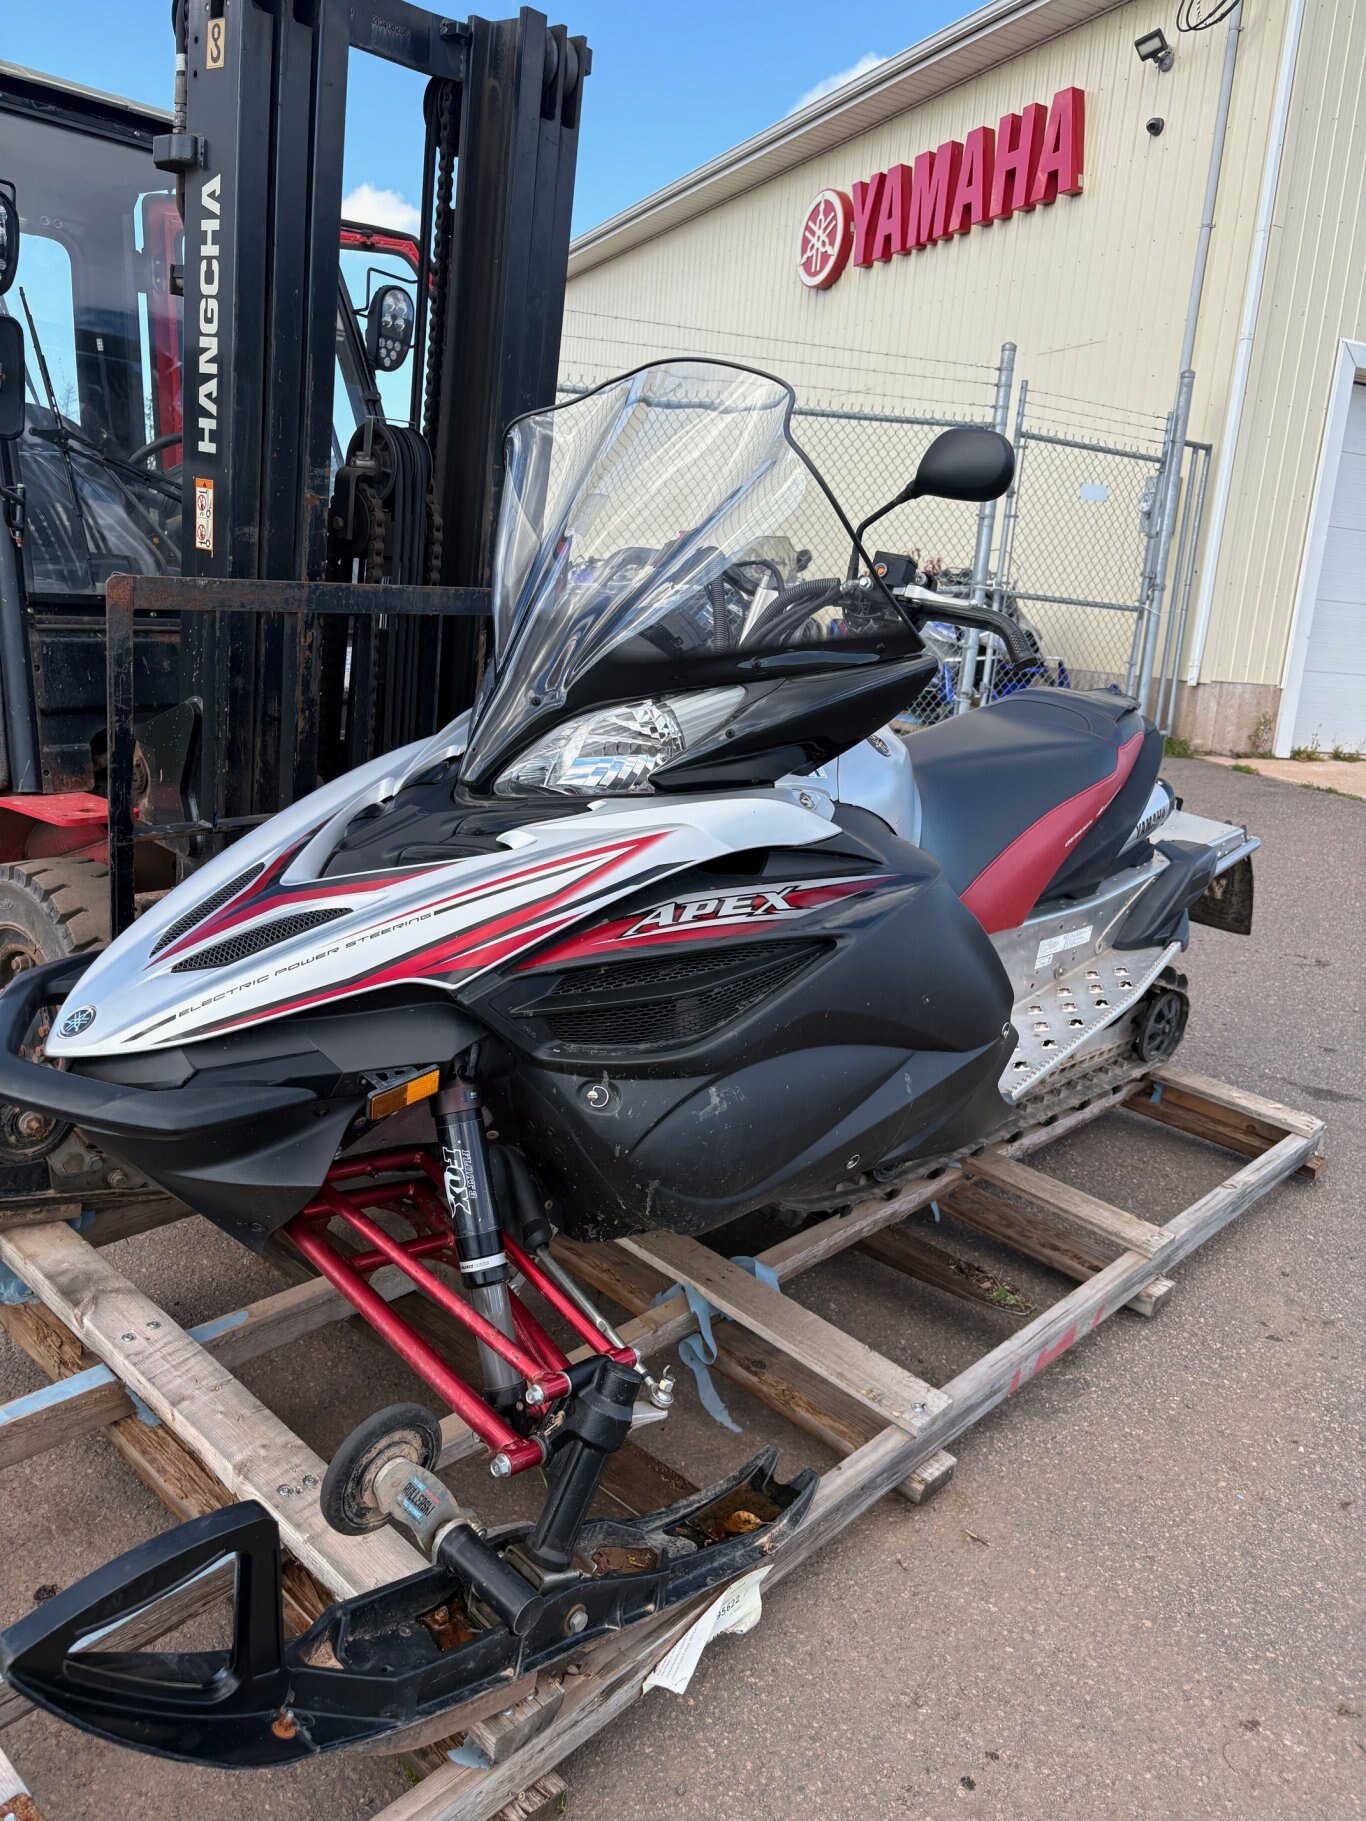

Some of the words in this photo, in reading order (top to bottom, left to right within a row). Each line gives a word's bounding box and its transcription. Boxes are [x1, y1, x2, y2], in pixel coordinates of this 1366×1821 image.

[852, 86, 1085, 268] YAMAHA
[198, 173, 222, 454] HANGCHA
[1136, 806, 1166, 840] YAMAHA
[617, 886, 802, 939] APEX
[178, 975, 270, 1018] ELECTRIC
[274, 946, 340, 977] POWER
[345, 912, 432, 949] STEERING
[442, 1146, 472, 1218] FOX
[462, 1150, 476, 1190] FLOAT
